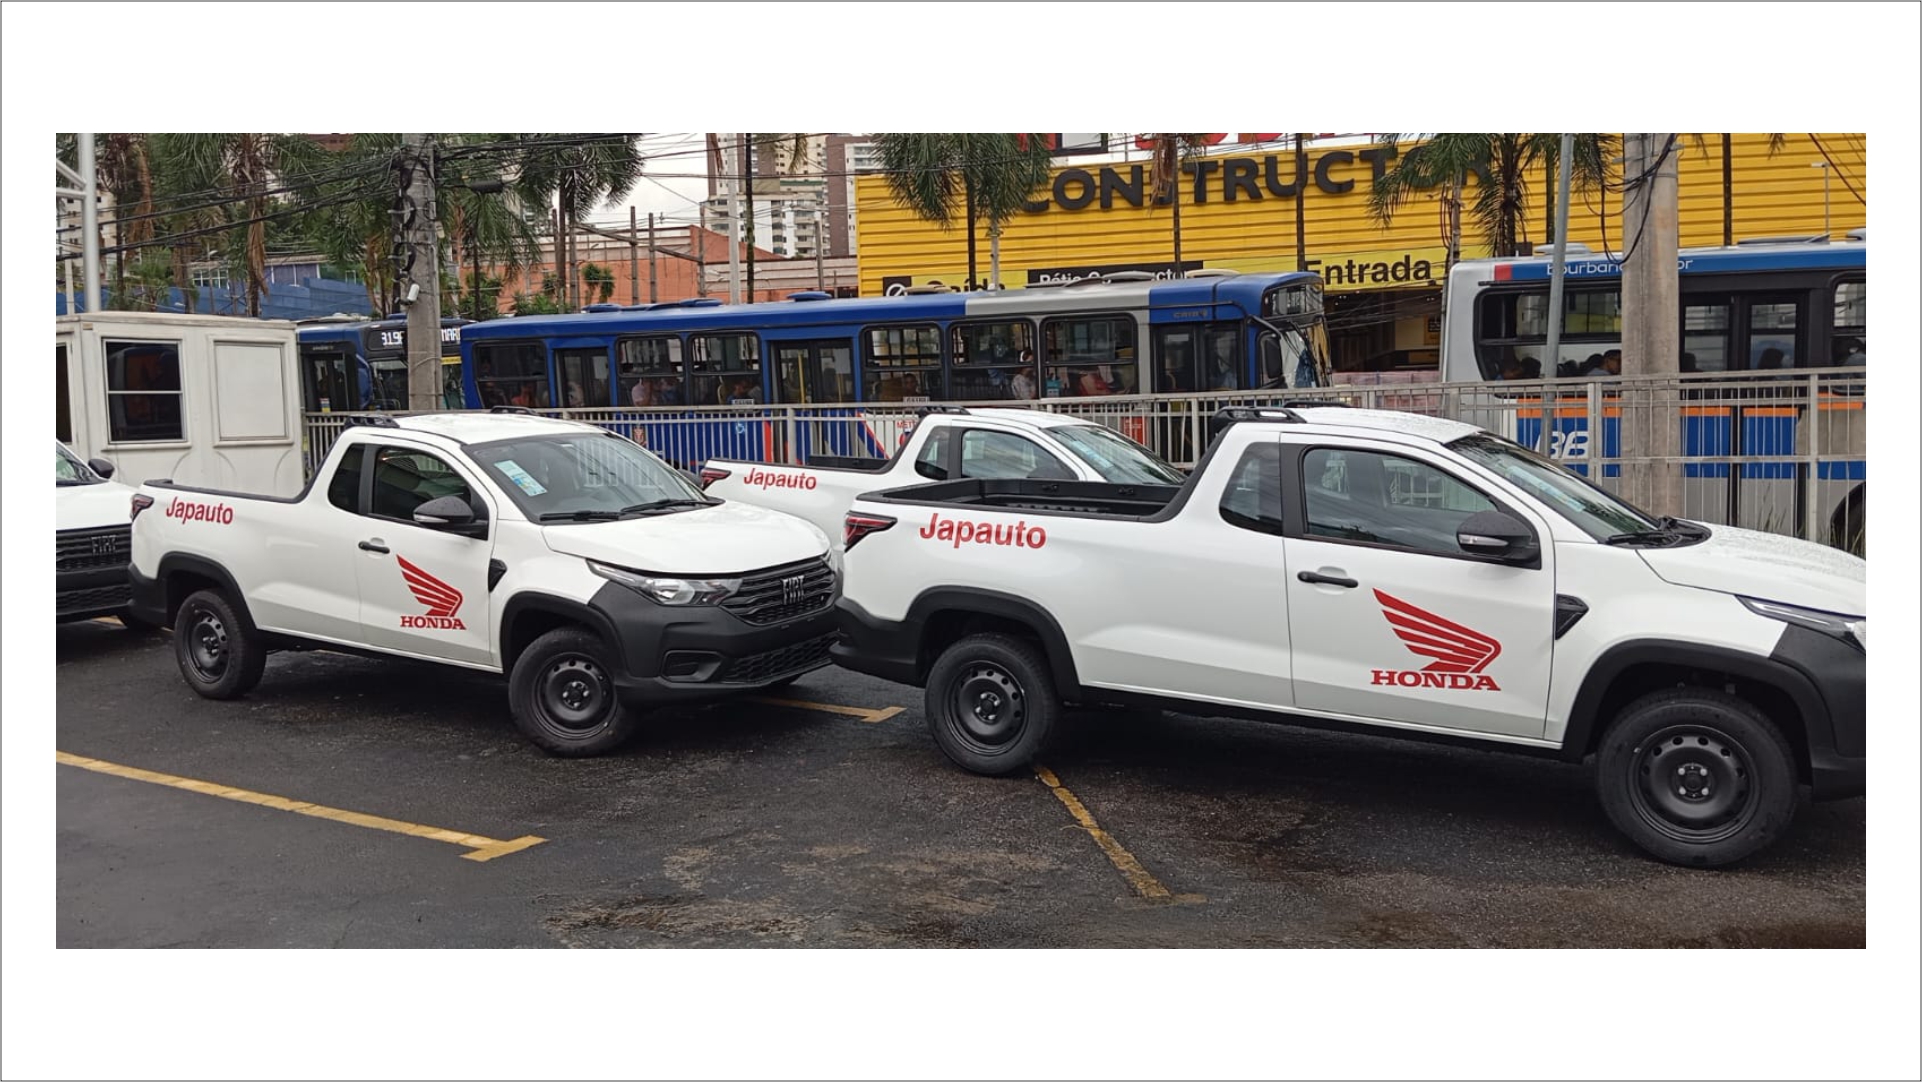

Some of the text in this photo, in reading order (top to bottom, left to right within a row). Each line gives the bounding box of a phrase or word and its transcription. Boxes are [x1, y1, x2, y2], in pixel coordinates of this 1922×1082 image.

[1020, 143, 1495, 214] ONTRUCTOR
[1304, 254, 1431, 285] Entrada
[744, 467, 817, 491] Japauto
[165, 496, 234, 525] Japauto
[919, 513, 1047, 549] Japauto
[781, 575, 805, 605] FIAT
[400, 616, 467, 630] HONDA
[1370, 670, 1502, 691] HONDA
